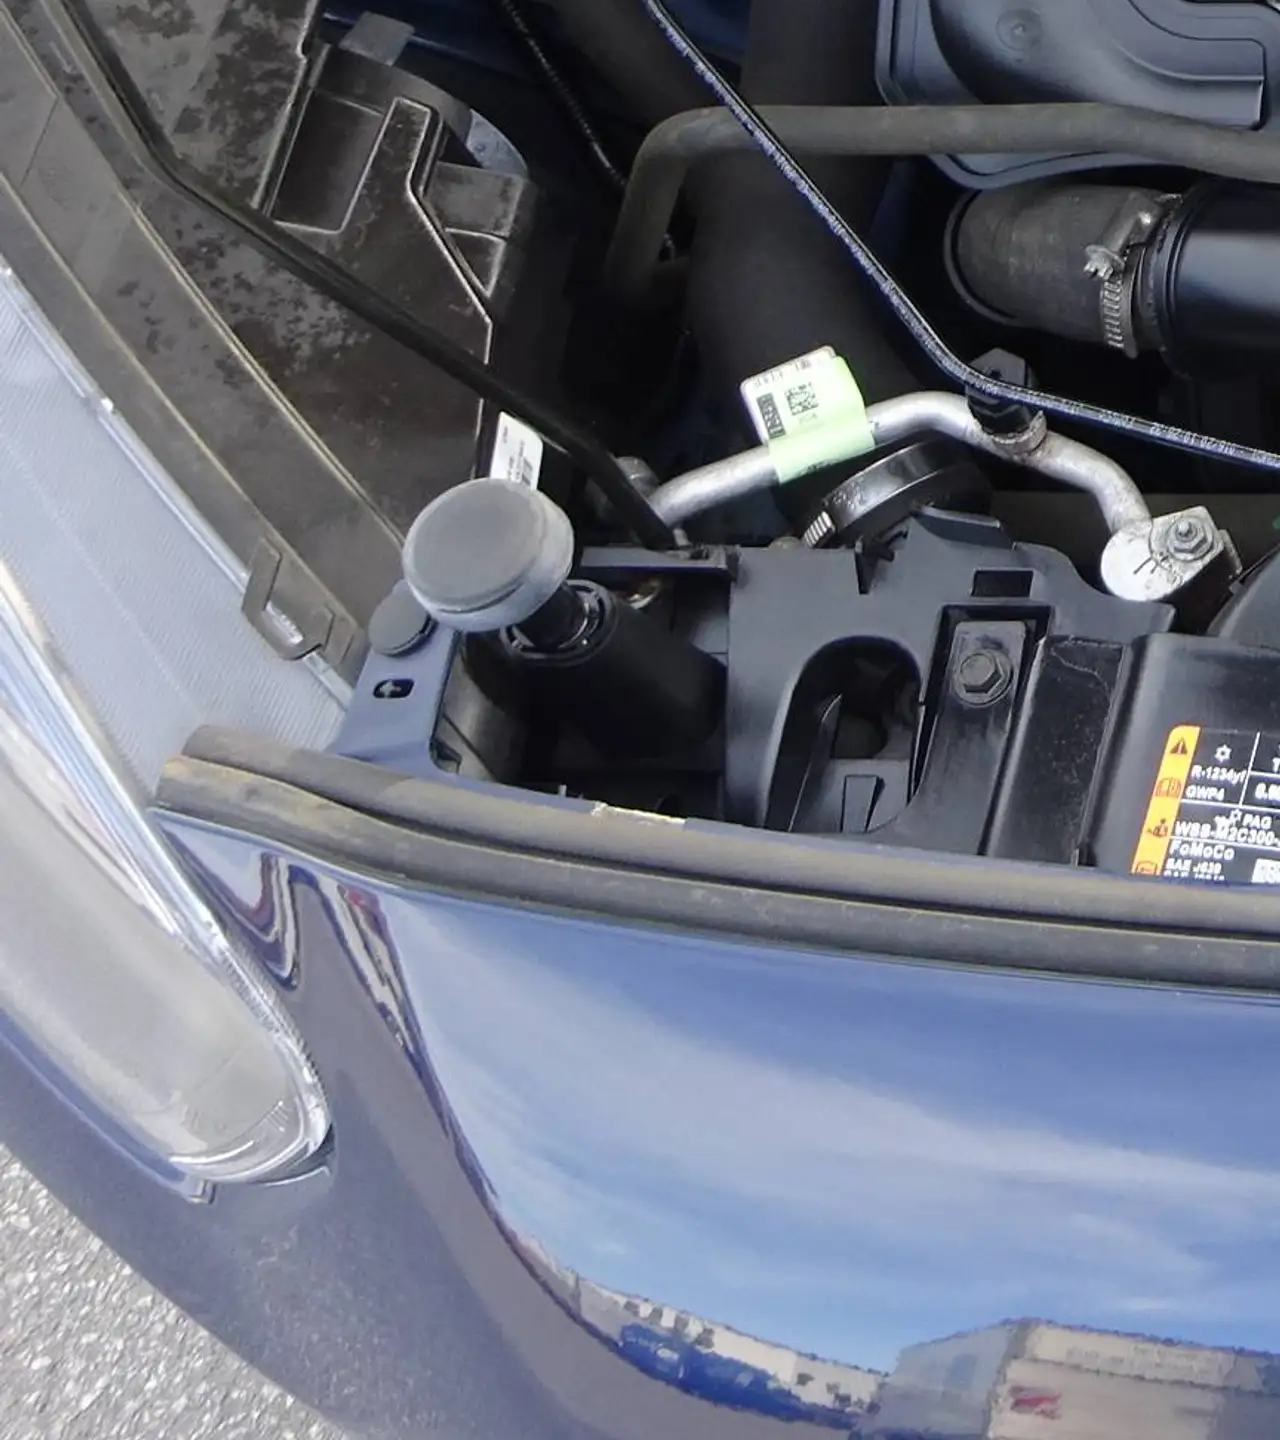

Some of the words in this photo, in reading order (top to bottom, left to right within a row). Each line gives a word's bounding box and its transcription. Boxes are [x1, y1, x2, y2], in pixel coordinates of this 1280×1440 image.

[1191, 764, 1247, 786] R-1234yf
[1242, 813, 1272, 830] PAG
[1169, 840, 1235, 860] FoMoCo
